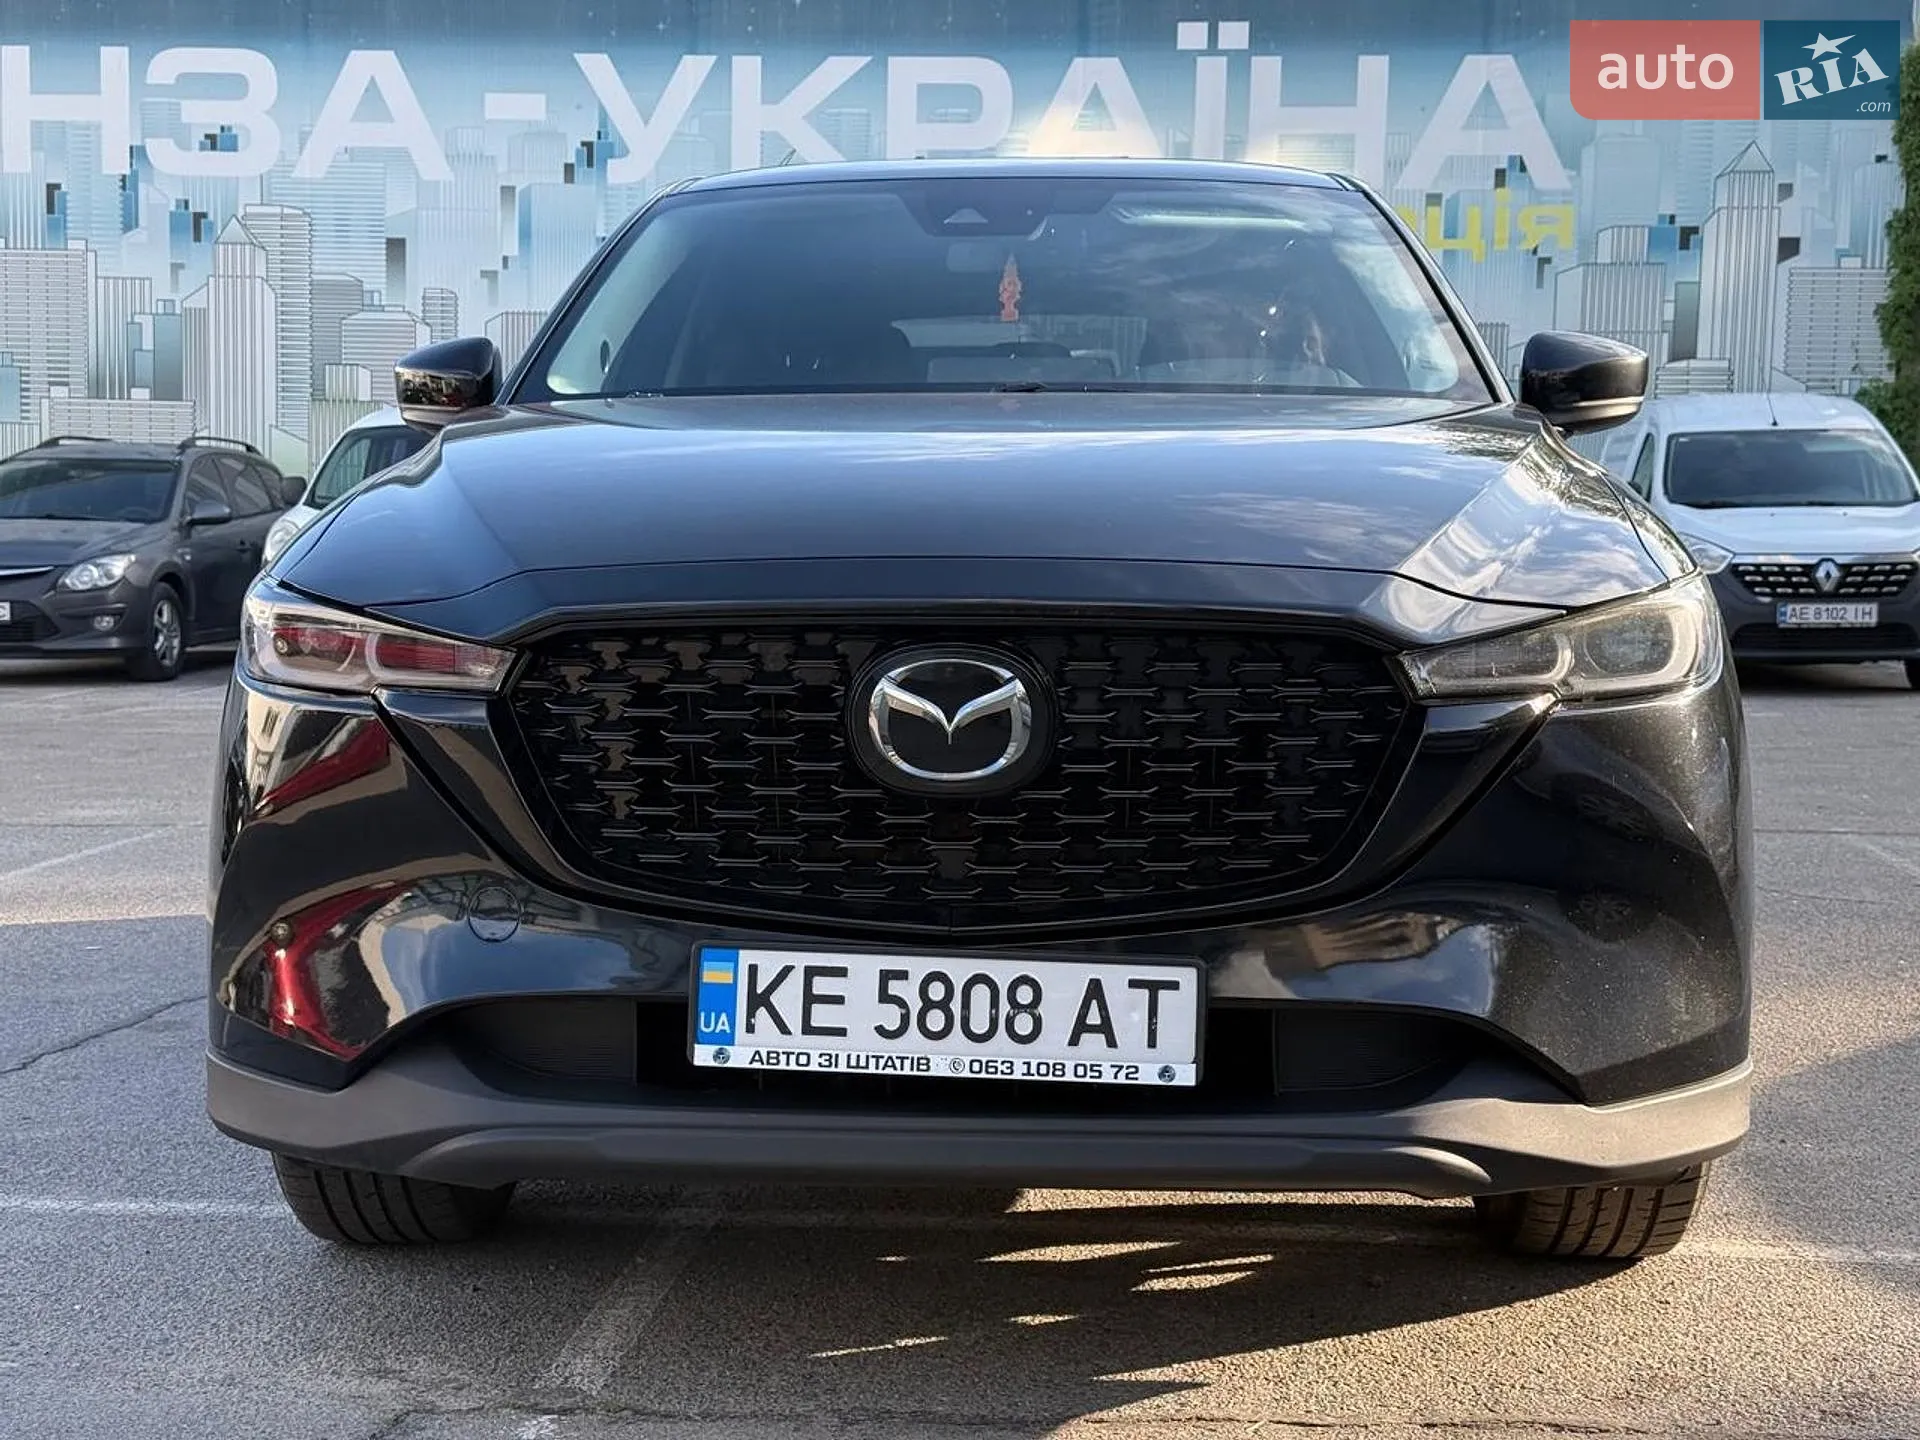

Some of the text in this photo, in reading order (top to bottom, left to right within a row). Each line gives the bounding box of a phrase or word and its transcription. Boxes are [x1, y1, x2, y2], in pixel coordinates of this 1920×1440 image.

[1813, 606, 1848, 621] 8102
[745, 963, 1180, 1049] KE 5808 AT
[700, 1012, 731, 1034] UA
[749, 1050, 1140, 1081] АВТО ЗІ ШТАТІВ 063 108 05 72
